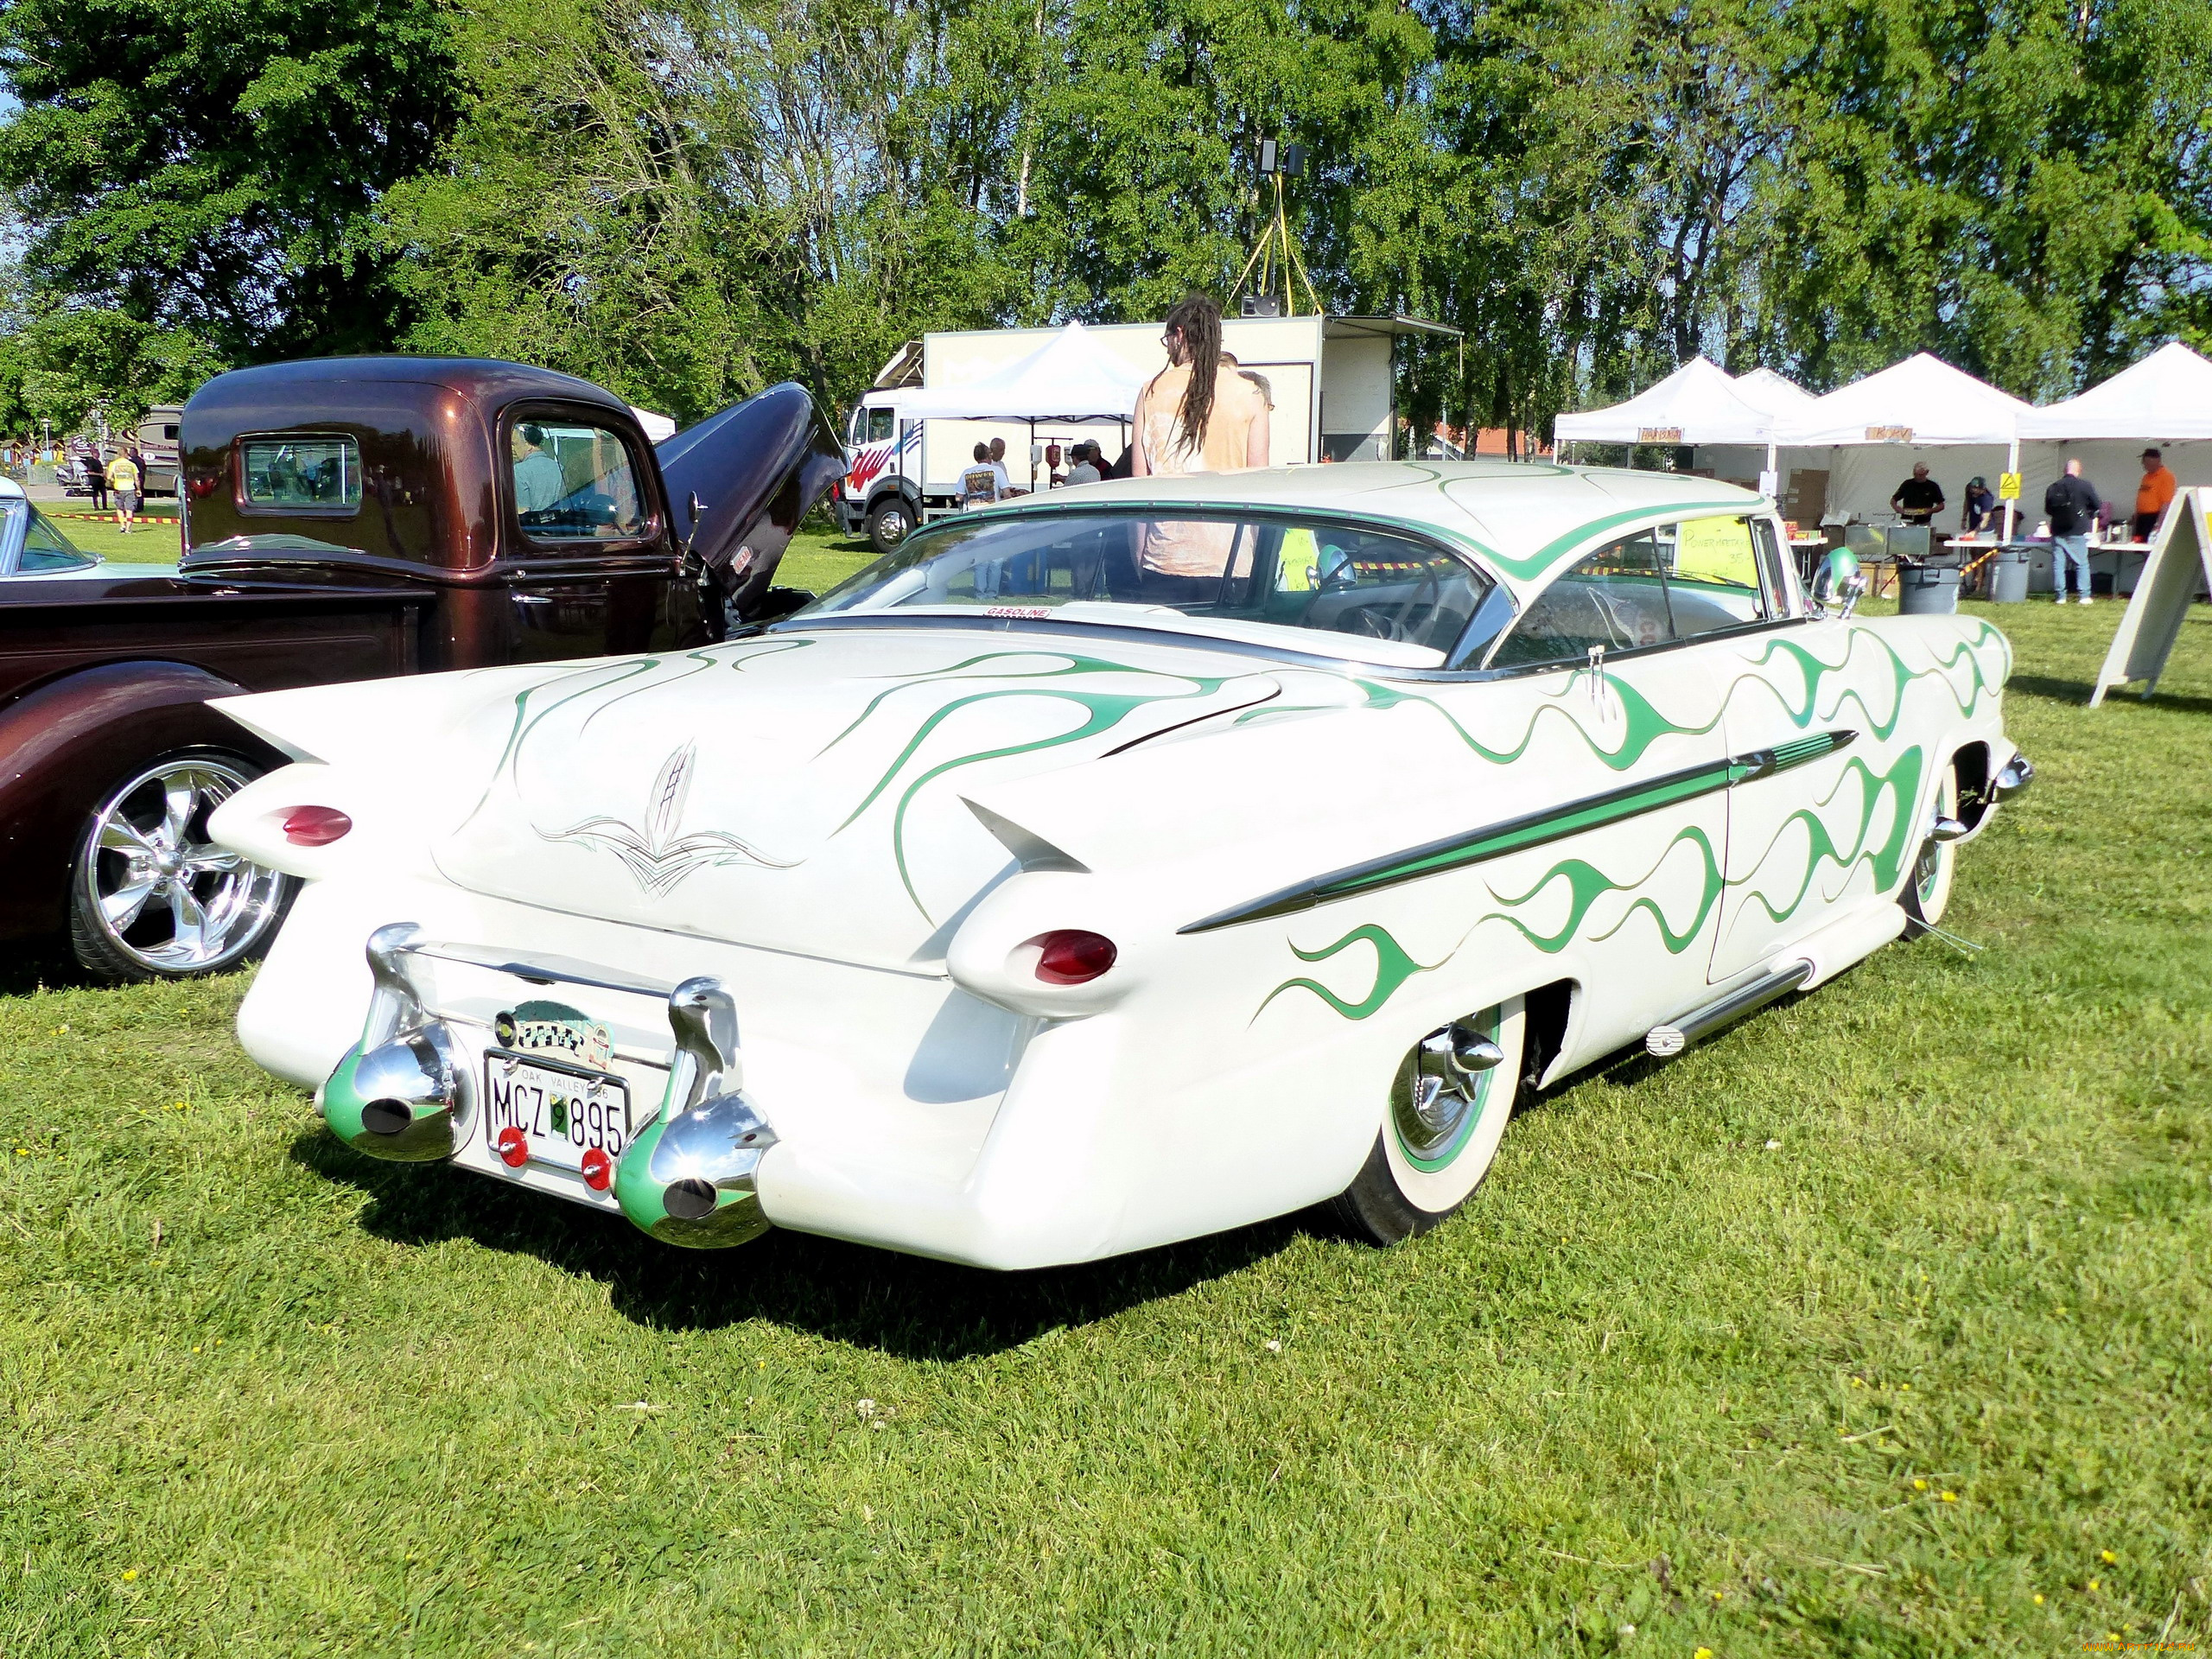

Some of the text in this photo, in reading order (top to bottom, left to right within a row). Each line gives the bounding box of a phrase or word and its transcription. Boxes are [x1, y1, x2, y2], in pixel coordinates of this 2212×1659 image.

[987, 607, 1048, 617] GASOLINE
[521, 1069, 542, 1083] OAK
[550, 1076, 586, 1093] VALLEY
[493, 1077, 546, 1137] MCZ
[570, 1096, 622, 1157] 895
